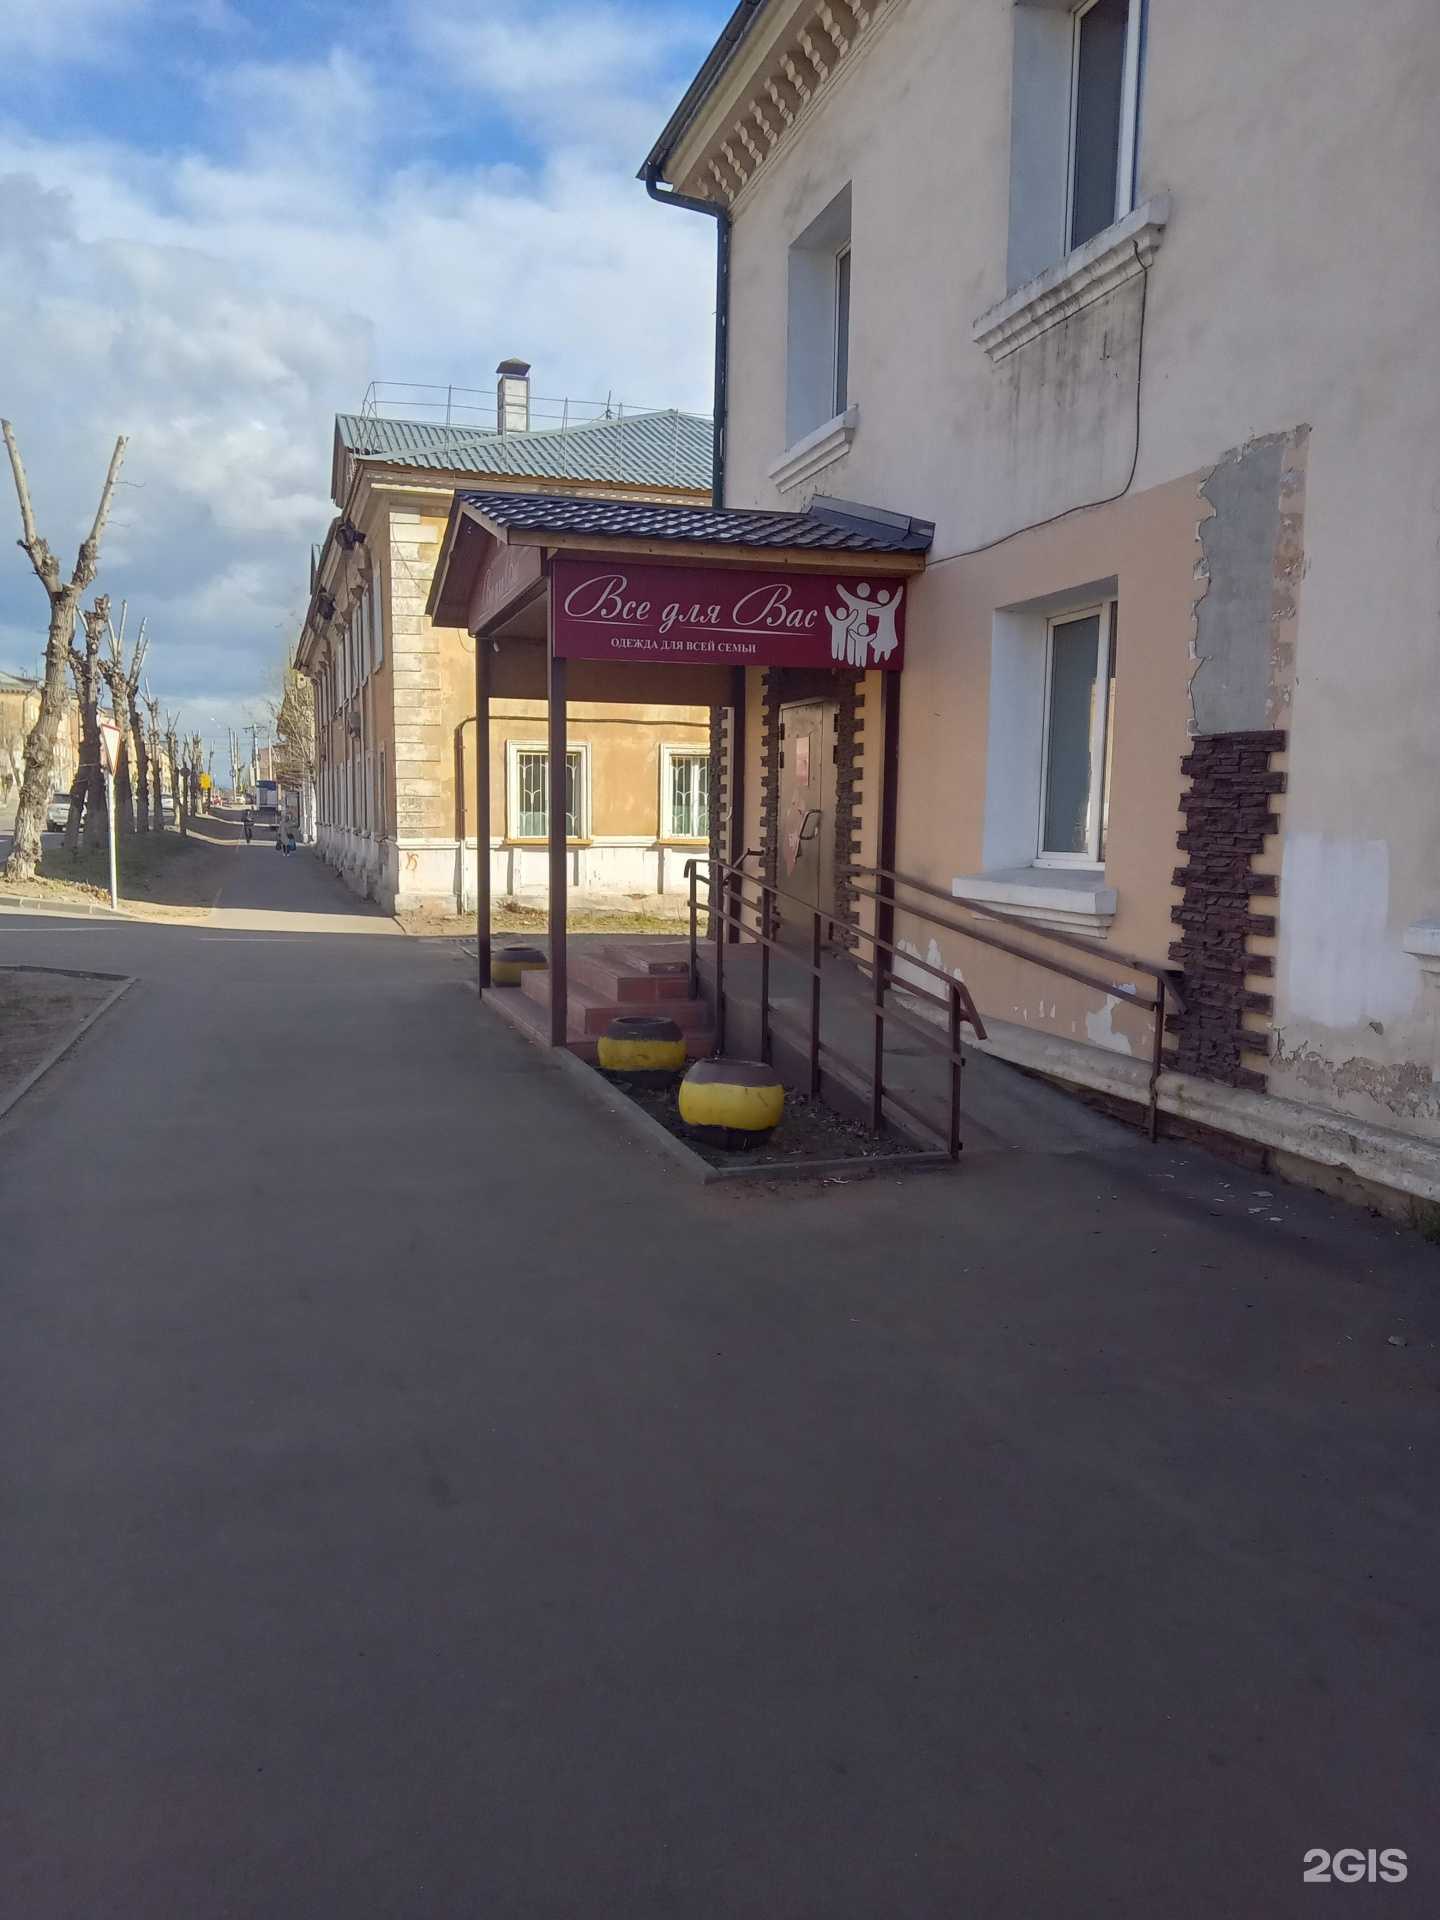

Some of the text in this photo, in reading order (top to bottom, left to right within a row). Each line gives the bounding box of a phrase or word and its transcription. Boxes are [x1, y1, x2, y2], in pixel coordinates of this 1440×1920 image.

[564, 574, 651, 620] Все
[658, 602, 721, 634] для
[732, 583, 818, 628] Вас
[610, 638, 757, 654] ОДЕЖДА ДЛЯ ВСЕЙ СЕМЬИ
